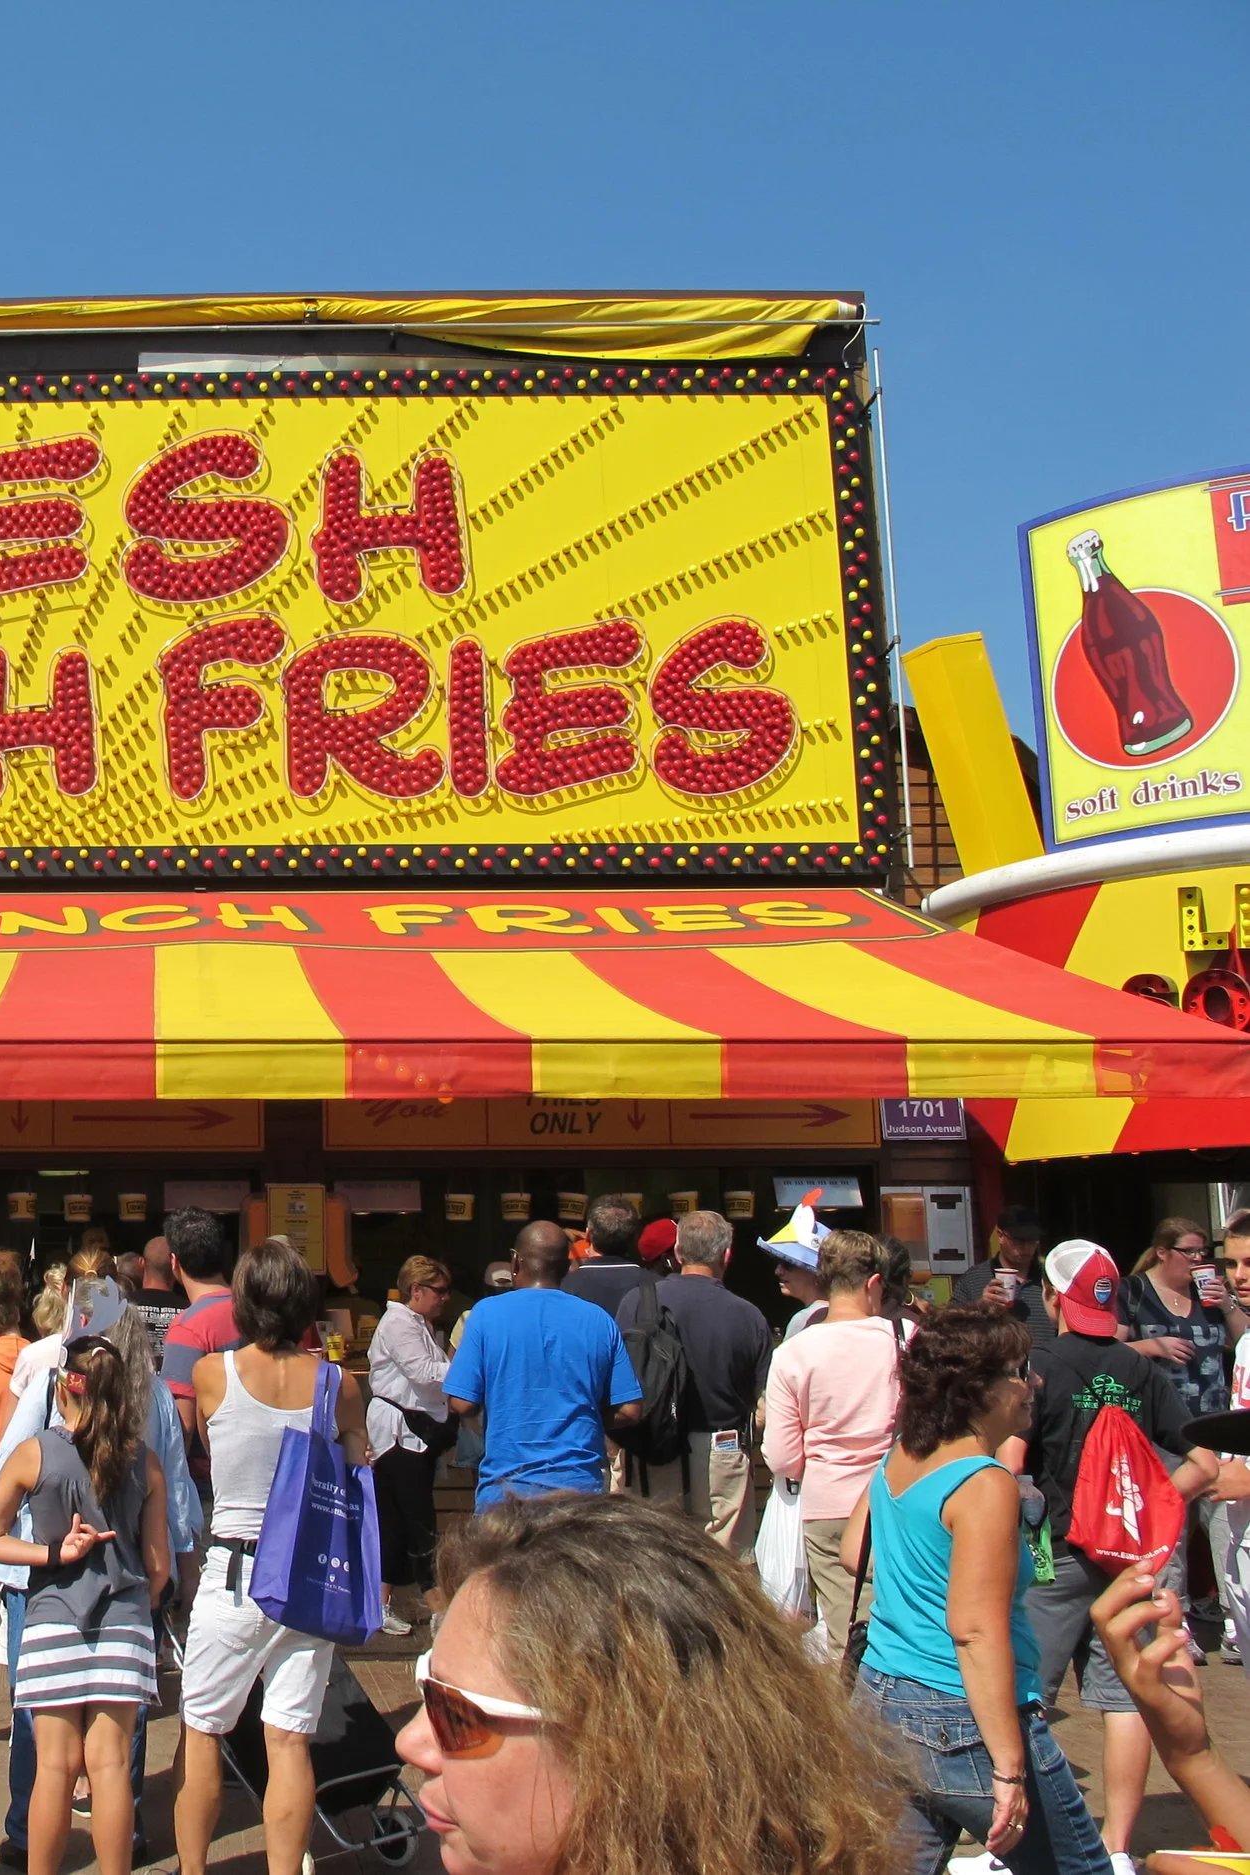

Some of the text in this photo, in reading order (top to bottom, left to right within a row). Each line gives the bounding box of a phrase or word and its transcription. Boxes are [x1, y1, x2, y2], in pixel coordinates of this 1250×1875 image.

[155, 610, 798, 800] FRIES
[1065, 770, 1242, 823] soft drinks
[368, 900, 862, 936] FRIES
[529, 1112, 602, 1135] ONLY
[899, 1100, 945, 1118] 1701
[887, 1124, 962, 1134] Judson Avenue
